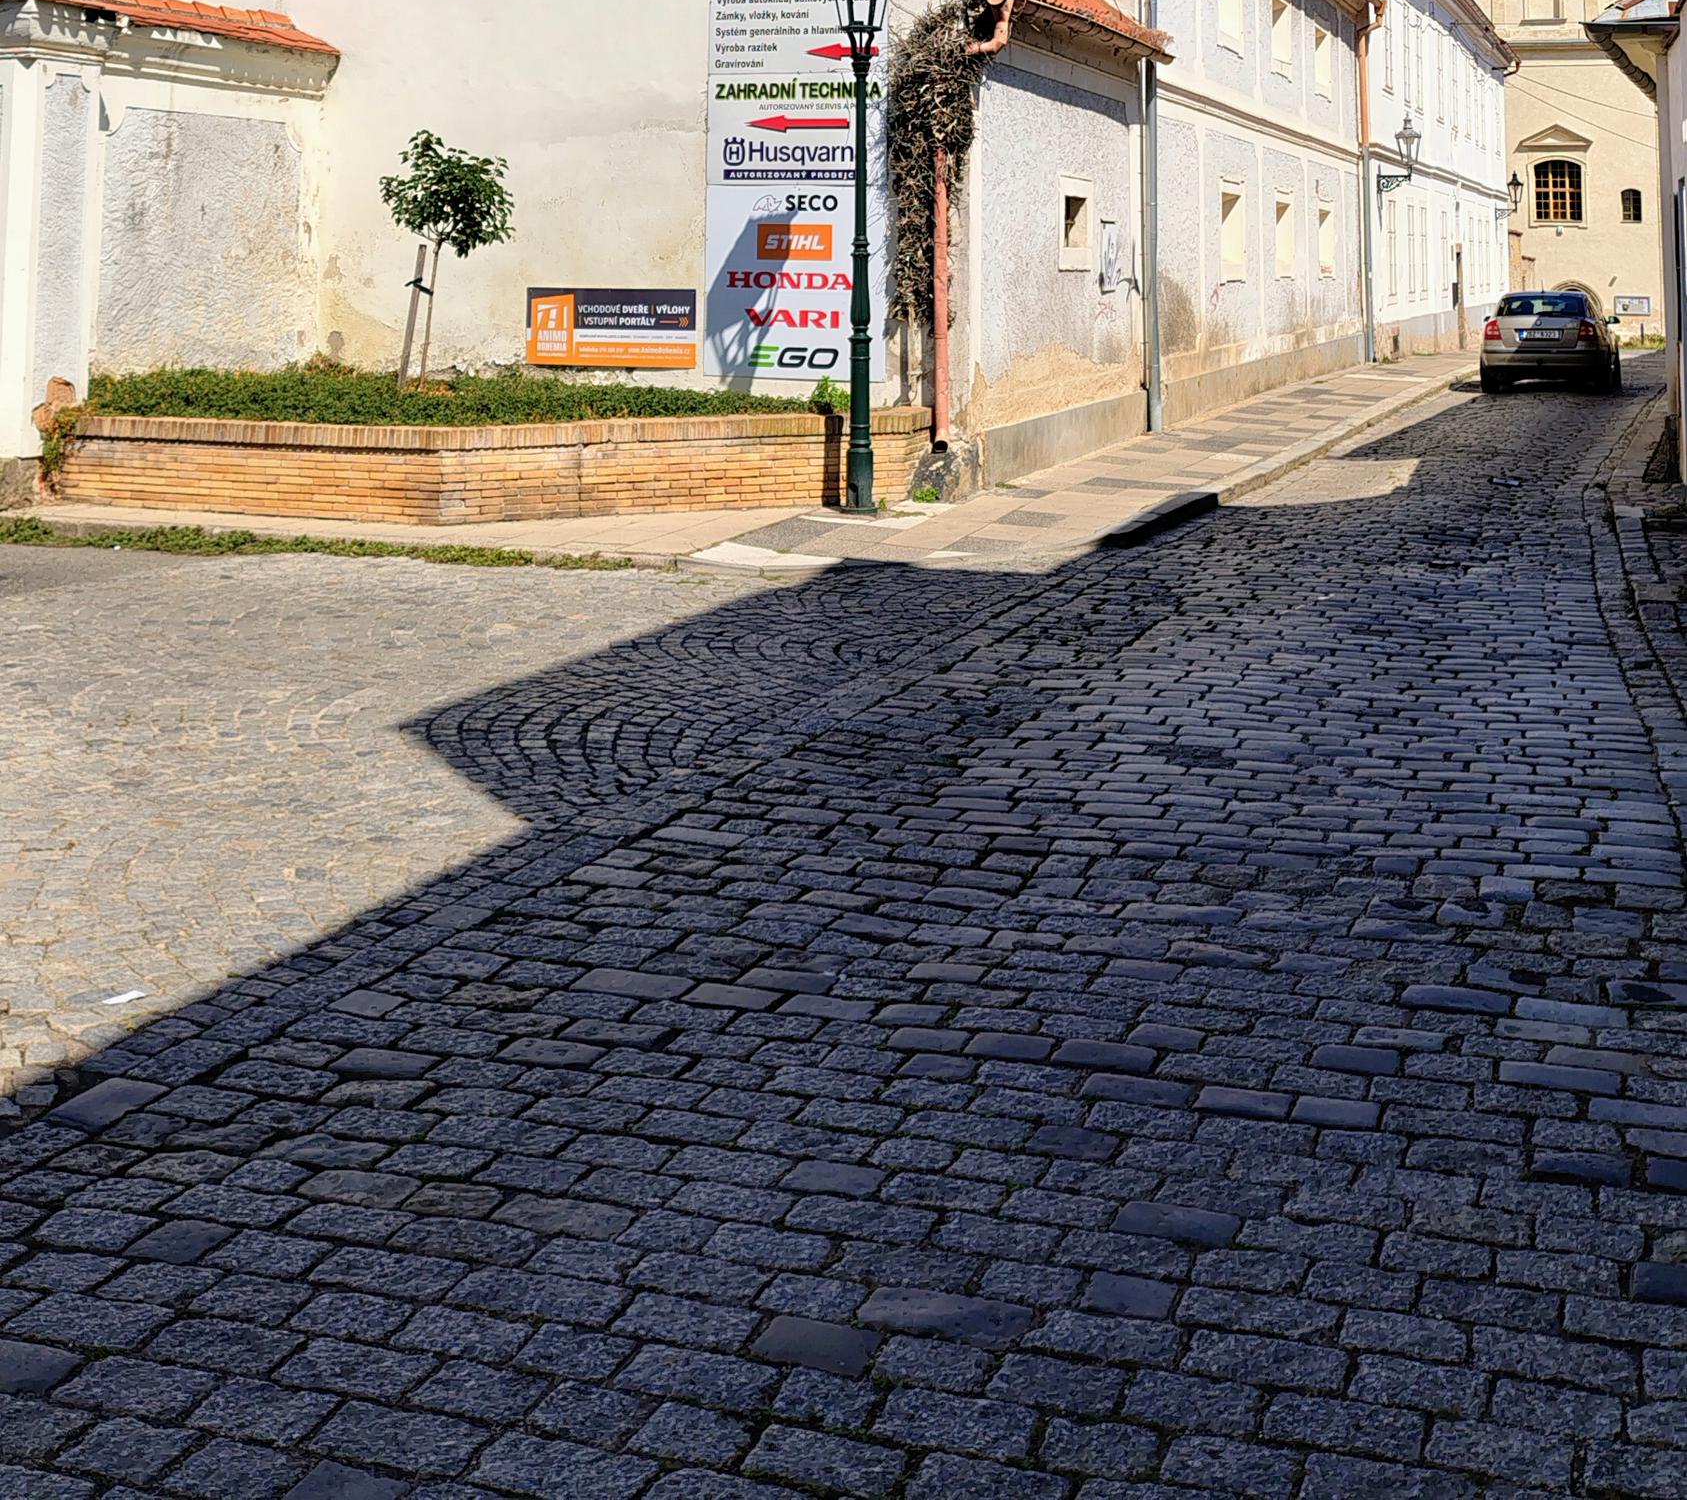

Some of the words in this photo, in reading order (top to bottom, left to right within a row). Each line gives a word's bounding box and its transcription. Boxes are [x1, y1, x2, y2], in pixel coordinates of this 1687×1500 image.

[715, 11, 747, 22] Zámky,
[749, 11, 779, 22] vložky,
[780, 9, 810, 19] kování
[715, 27, 747, 38] Systém
[749, 25, 801, 37] generálního
[715, 43, 745, 54] Výroba
[747, 42, 778, 52] razítek
[715, 59, 764, 68] Gravírování
[715, 78, 797, 100] ZAHRADNÍ
[799, 81, 882, 100] TECHNIA
[759, 102, 814, 110] AUTORIZOVANÝ
[815, 102, 841, 110] SERVIS
[843, 102, 849, 110] A
[748, 141, 855, 166] Husqvarn
[729, 170, 807, 179] AUTORIZOVANÝ
[811, 171, 854, 180] PRODEJC
[785, 194, 838, 212] SECO
[764, 234, 825, 250] STIHL
[726, 271, 855, 290] HONDA
[578, 303, 621, 314] VCHODOVÉ
[622, 303, 648, 314] DVEŘE
[656, 303, 690, 315] VÝLOHY
[584, 315, 618, 326] VSTUPNÍ
[619, 315, 656, 327] PORTÁLY
[744, 308, 839, 329] VARI
[537, 330, 567, 341] ANIMO
[748, 345, 839, 369] EGO
